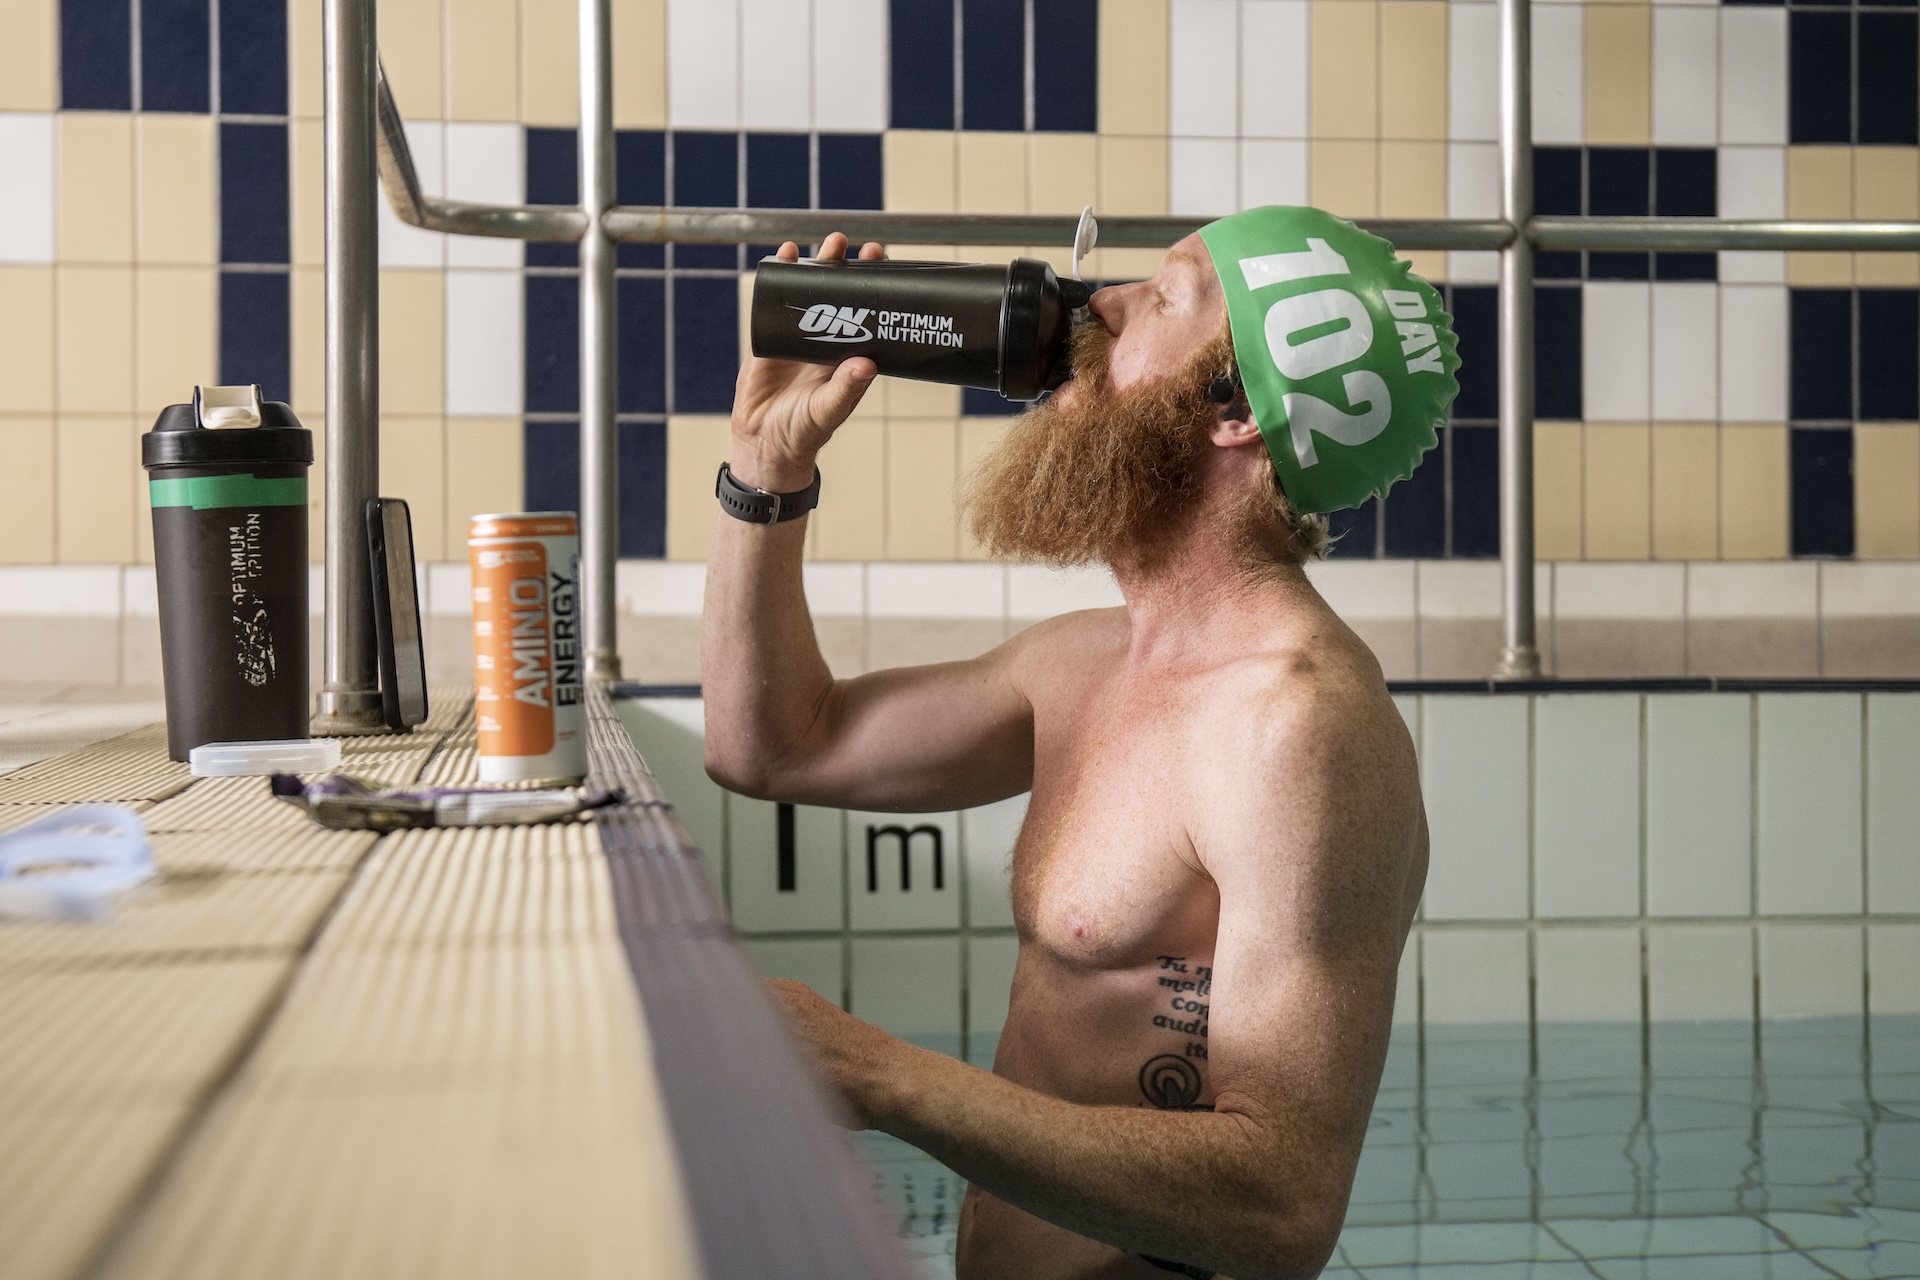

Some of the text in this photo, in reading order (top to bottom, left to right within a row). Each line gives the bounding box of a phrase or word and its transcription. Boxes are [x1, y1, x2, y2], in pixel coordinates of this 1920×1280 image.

[877, 325, 963, 348] NUTRITION
[878, 310, 953, 331] OPTIMUM
[1238, 238, 1391, 469] 102
[1382, 290, 1445, 374] DAY
[552, 574, 577, 706] ENERGY
[867, 824, 943, 892] m
[1157, 956, 1188, 973] Tu
